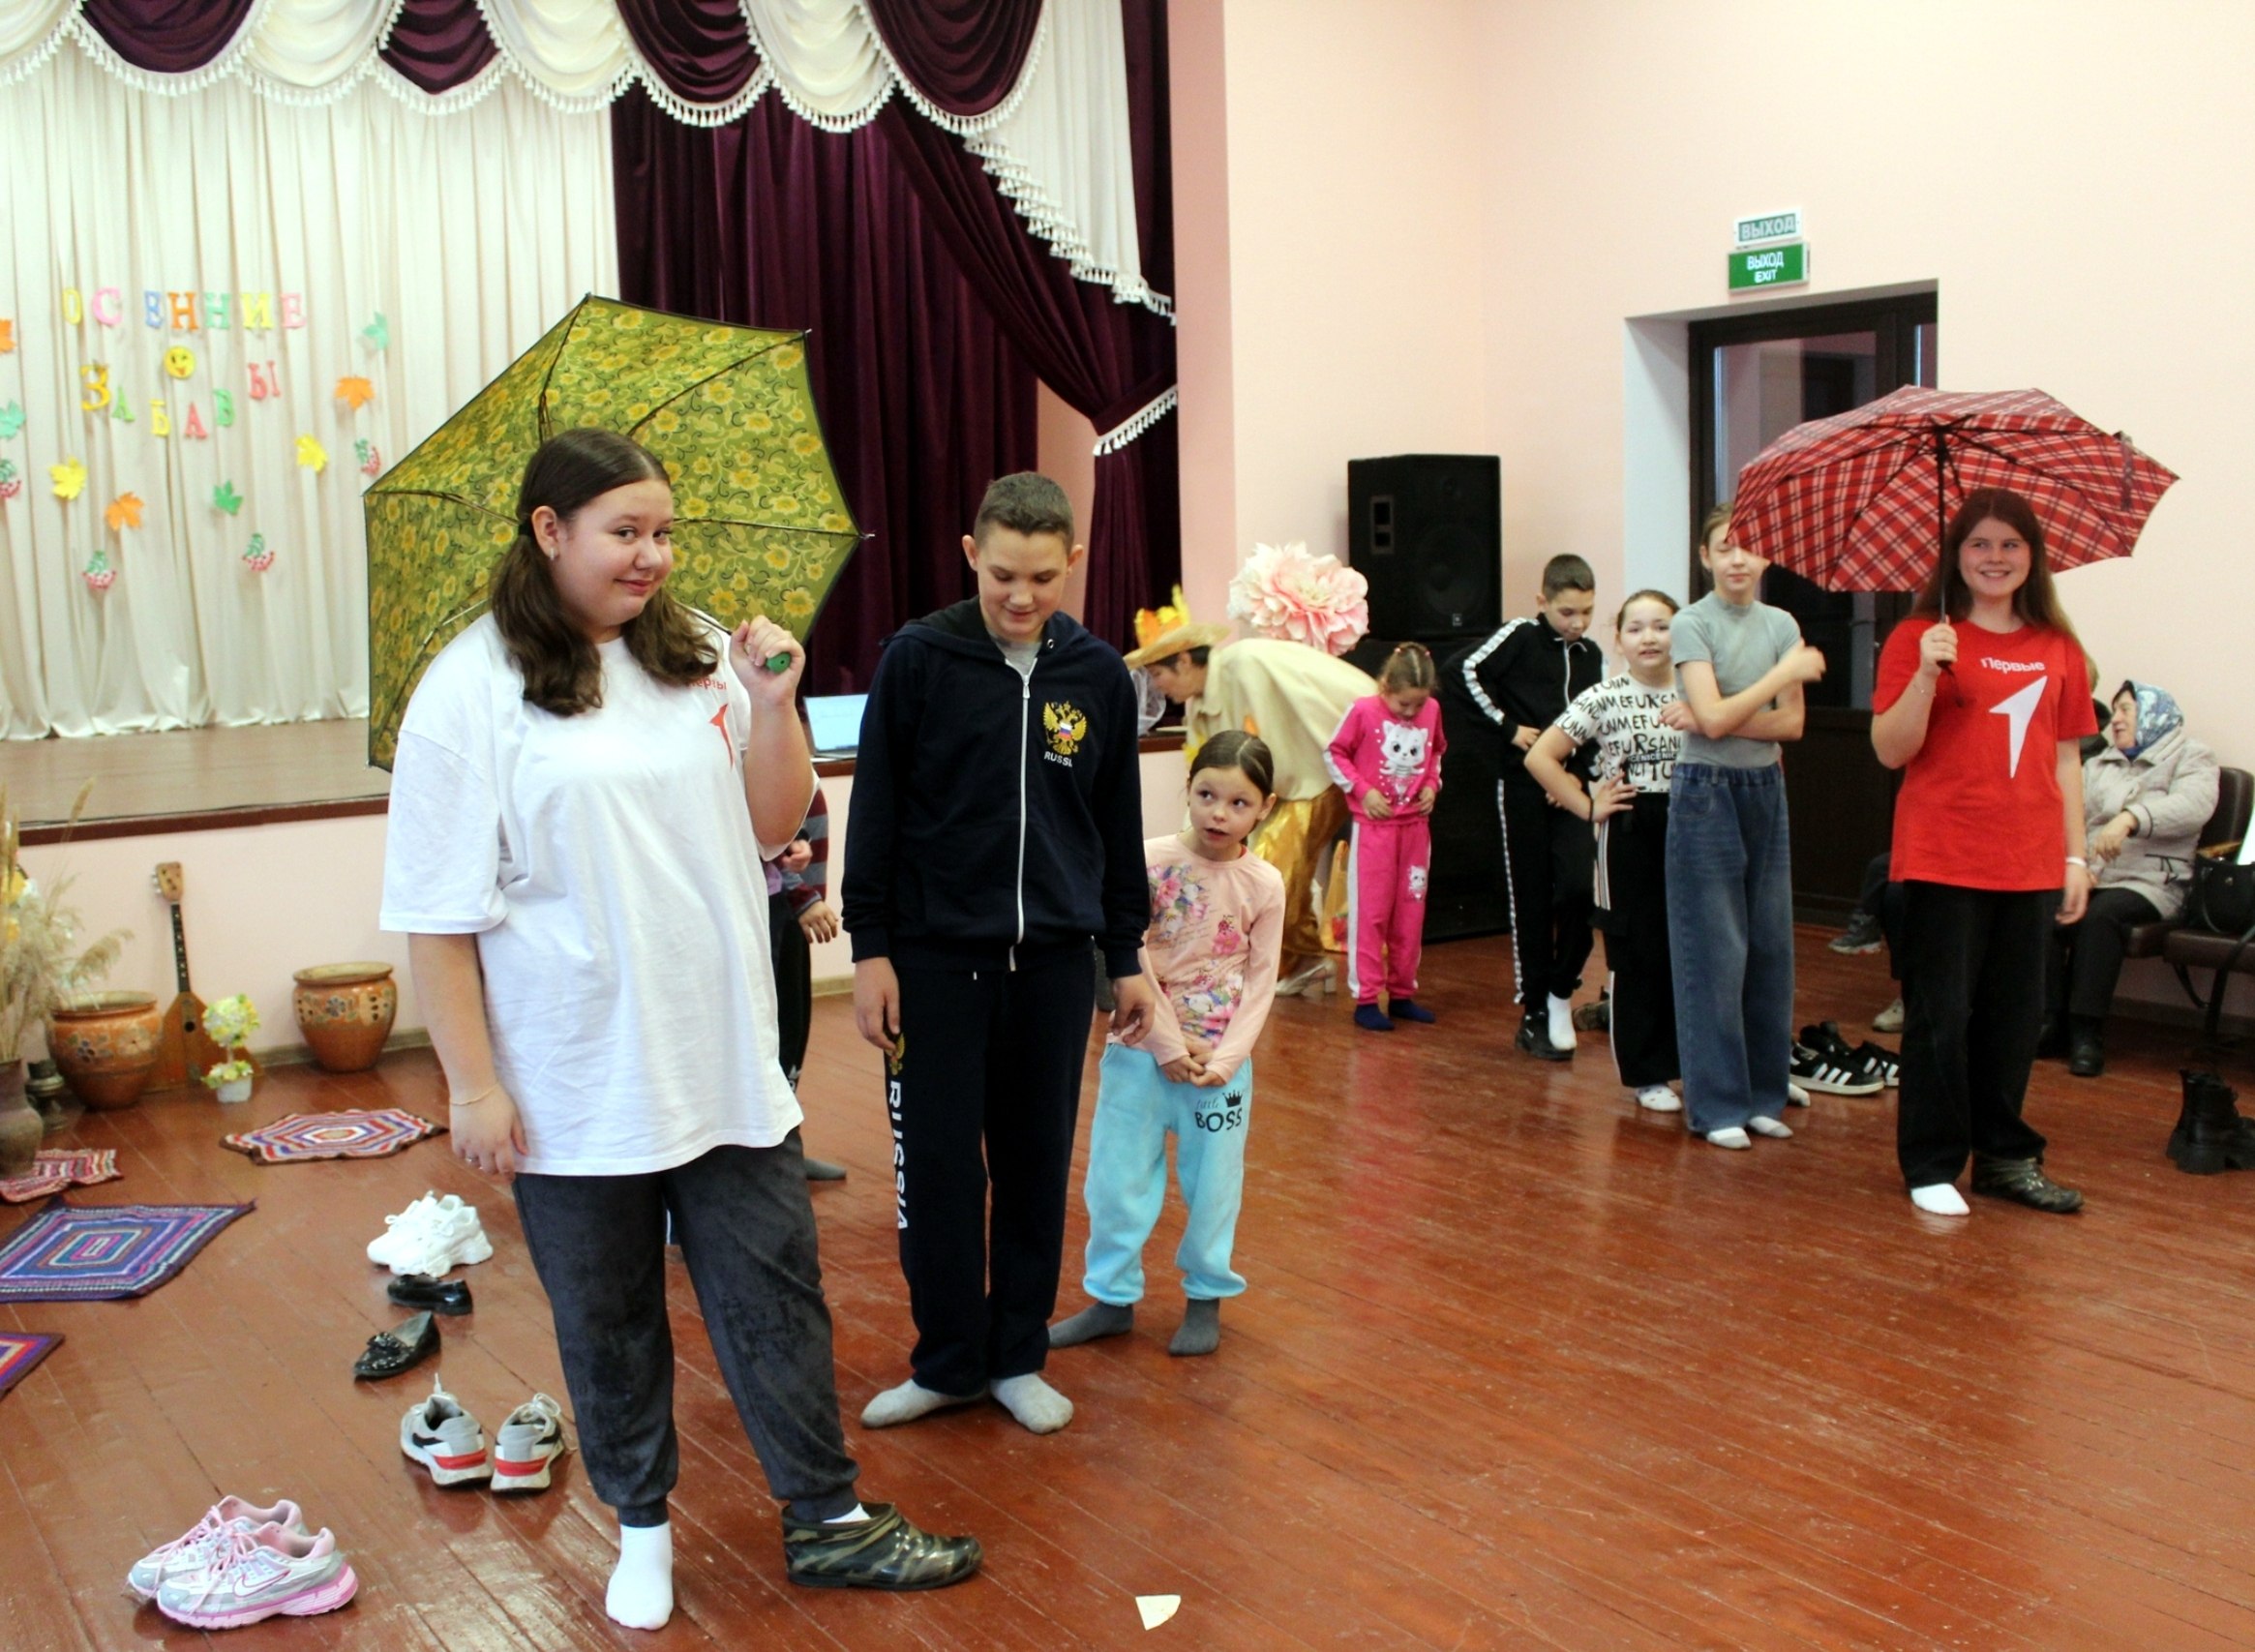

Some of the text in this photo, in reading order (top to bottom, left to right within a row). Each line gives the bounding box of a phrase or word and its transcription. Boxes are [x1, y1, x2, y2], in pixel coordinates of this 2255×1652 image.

[1741, 216, 1794, 240] ВЫХОД
[1747, 252, 1784, 270] ВЫХОД
[1755, 269, 1777, 284] EXIT
[1980, 657, 2045, 674] Первые
[1194, 1107, 1243, 1133] BOSS
